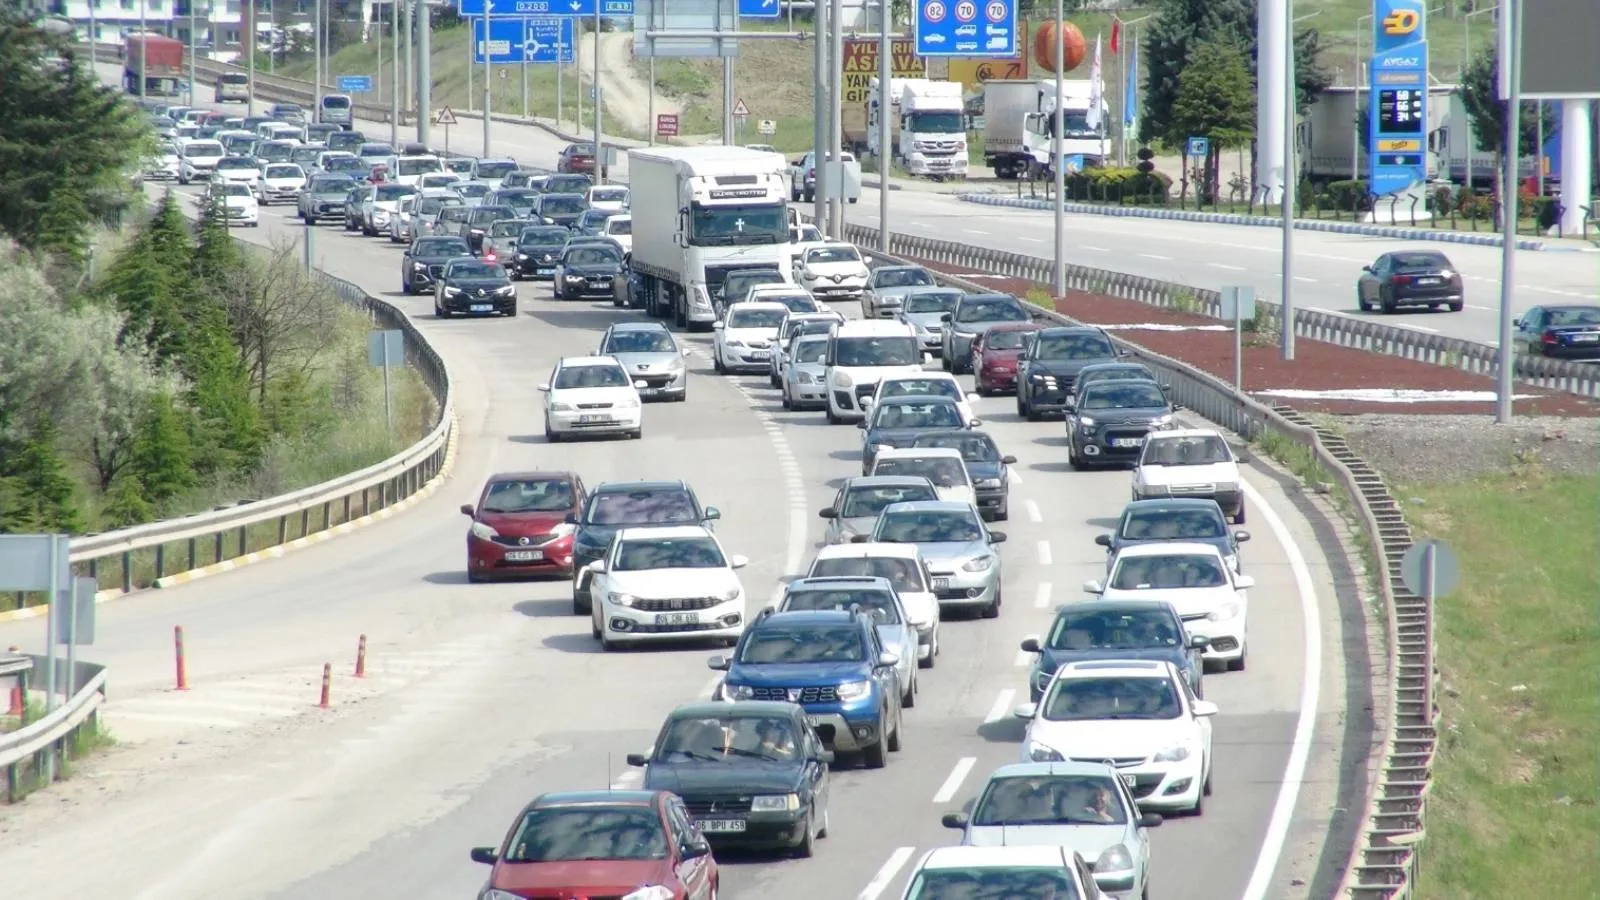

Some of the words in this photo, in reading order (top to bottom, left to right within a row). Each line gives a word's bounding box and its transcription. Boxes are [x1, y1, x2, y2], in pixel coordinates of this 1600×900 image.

[929, 6, 941, 16] 82
[961, 6, 972, 16] 70
[992, 6, 1003, 16] 70
